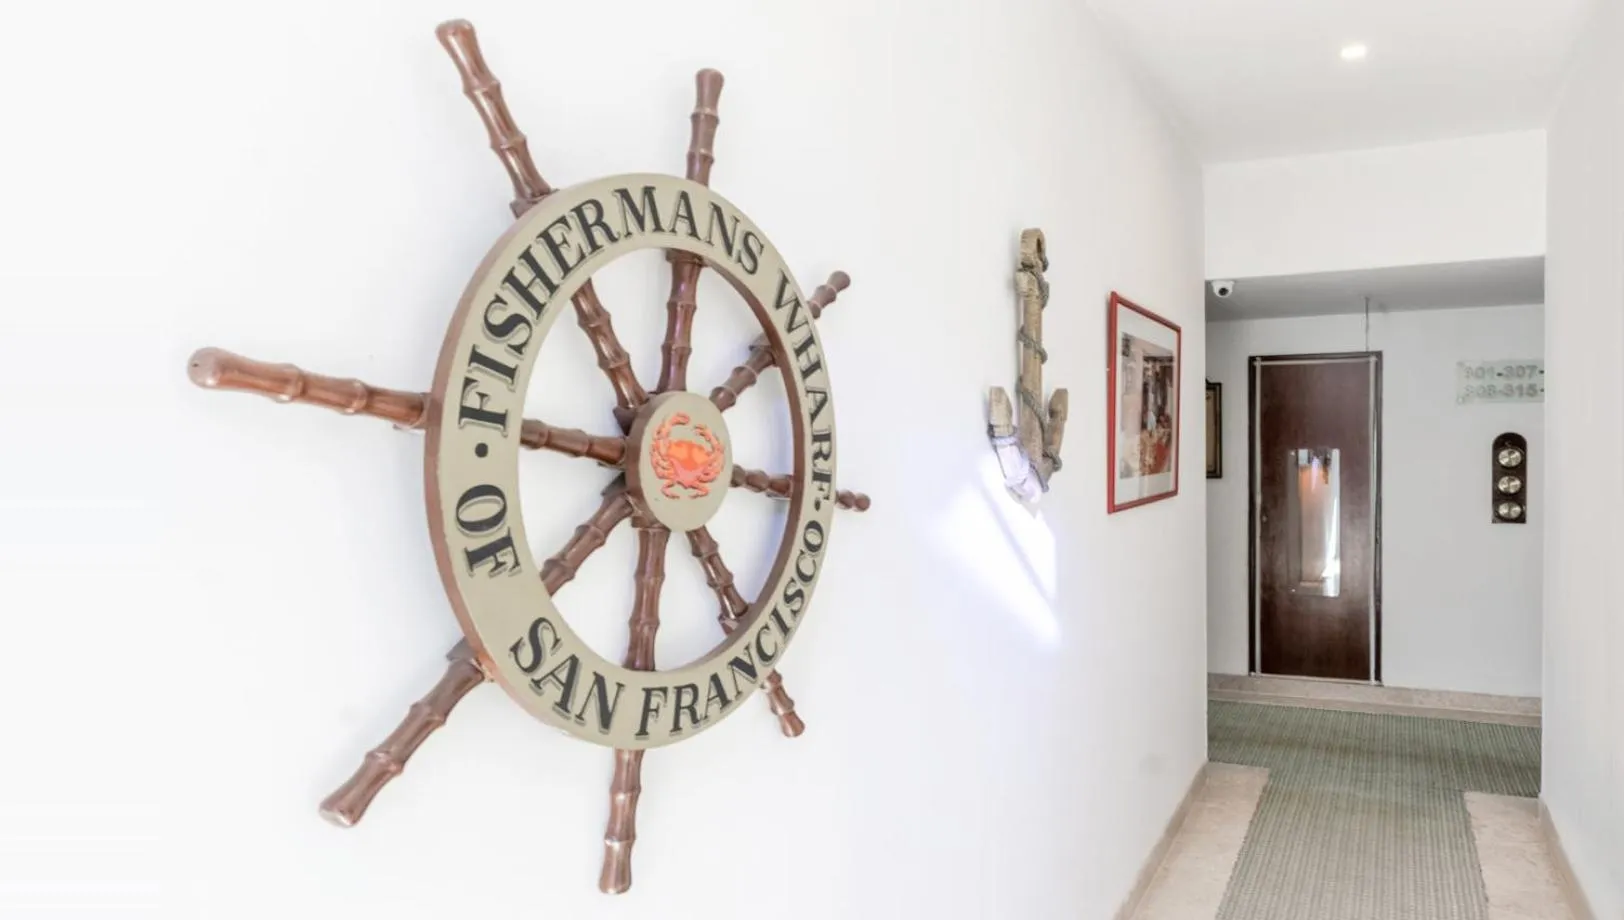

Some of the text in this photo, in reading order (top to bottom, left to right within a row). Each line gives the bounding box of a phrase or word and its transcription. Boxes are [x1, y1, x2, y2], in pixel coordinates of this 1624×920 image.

[459, 185, 835, 502] FISHERMANS WHARF
[455, 483, 825, 739] OF SAN FRANCISCO
